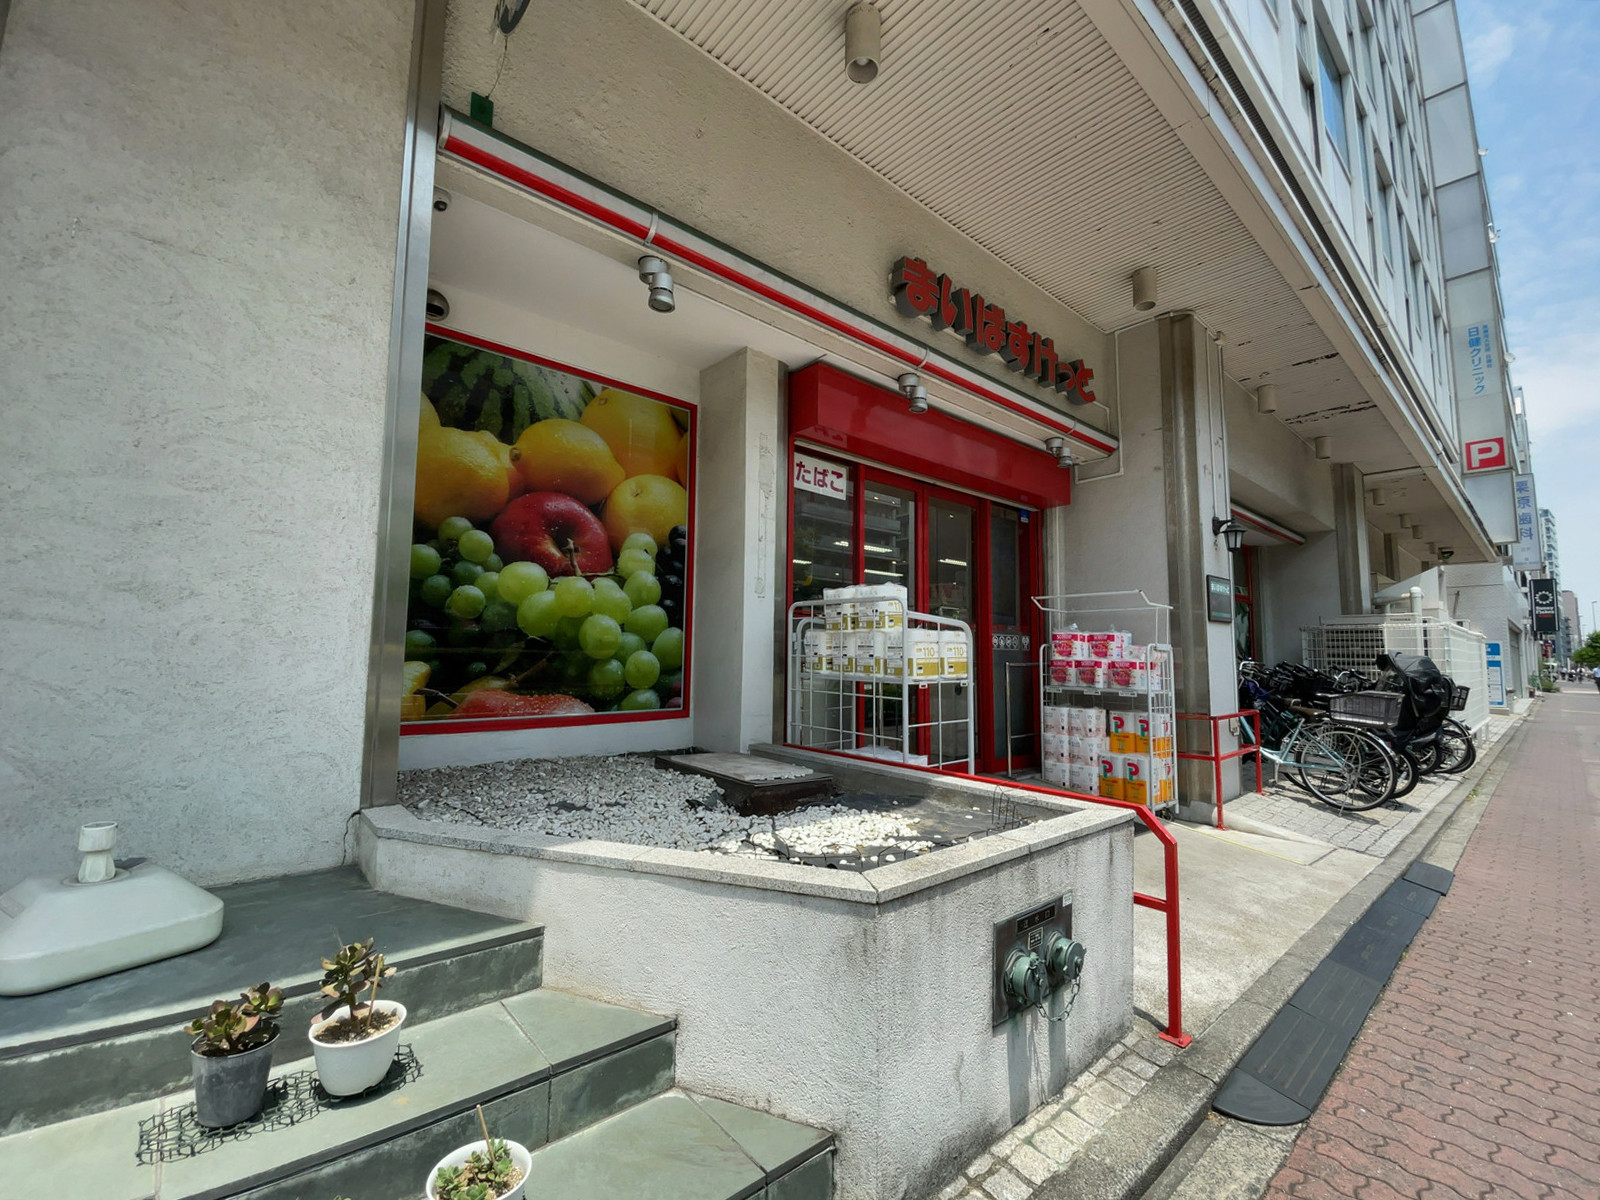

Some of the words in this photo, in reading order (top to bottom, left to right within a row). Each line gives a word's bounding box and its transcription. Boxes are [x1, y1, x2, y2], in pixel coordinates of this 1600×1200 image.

[894, 256, 1096, 405] まいばすけっと
[1468, 326, 1485, 395] 日健クリニック
[1470, 441, 1500, 468] P
[796, 461, 843, 493] たばこ
[1516, 480, 1534, 540] 栗原歯科
[922, 647, 935, 657] 110
[953, 647, 964, 656] 110
